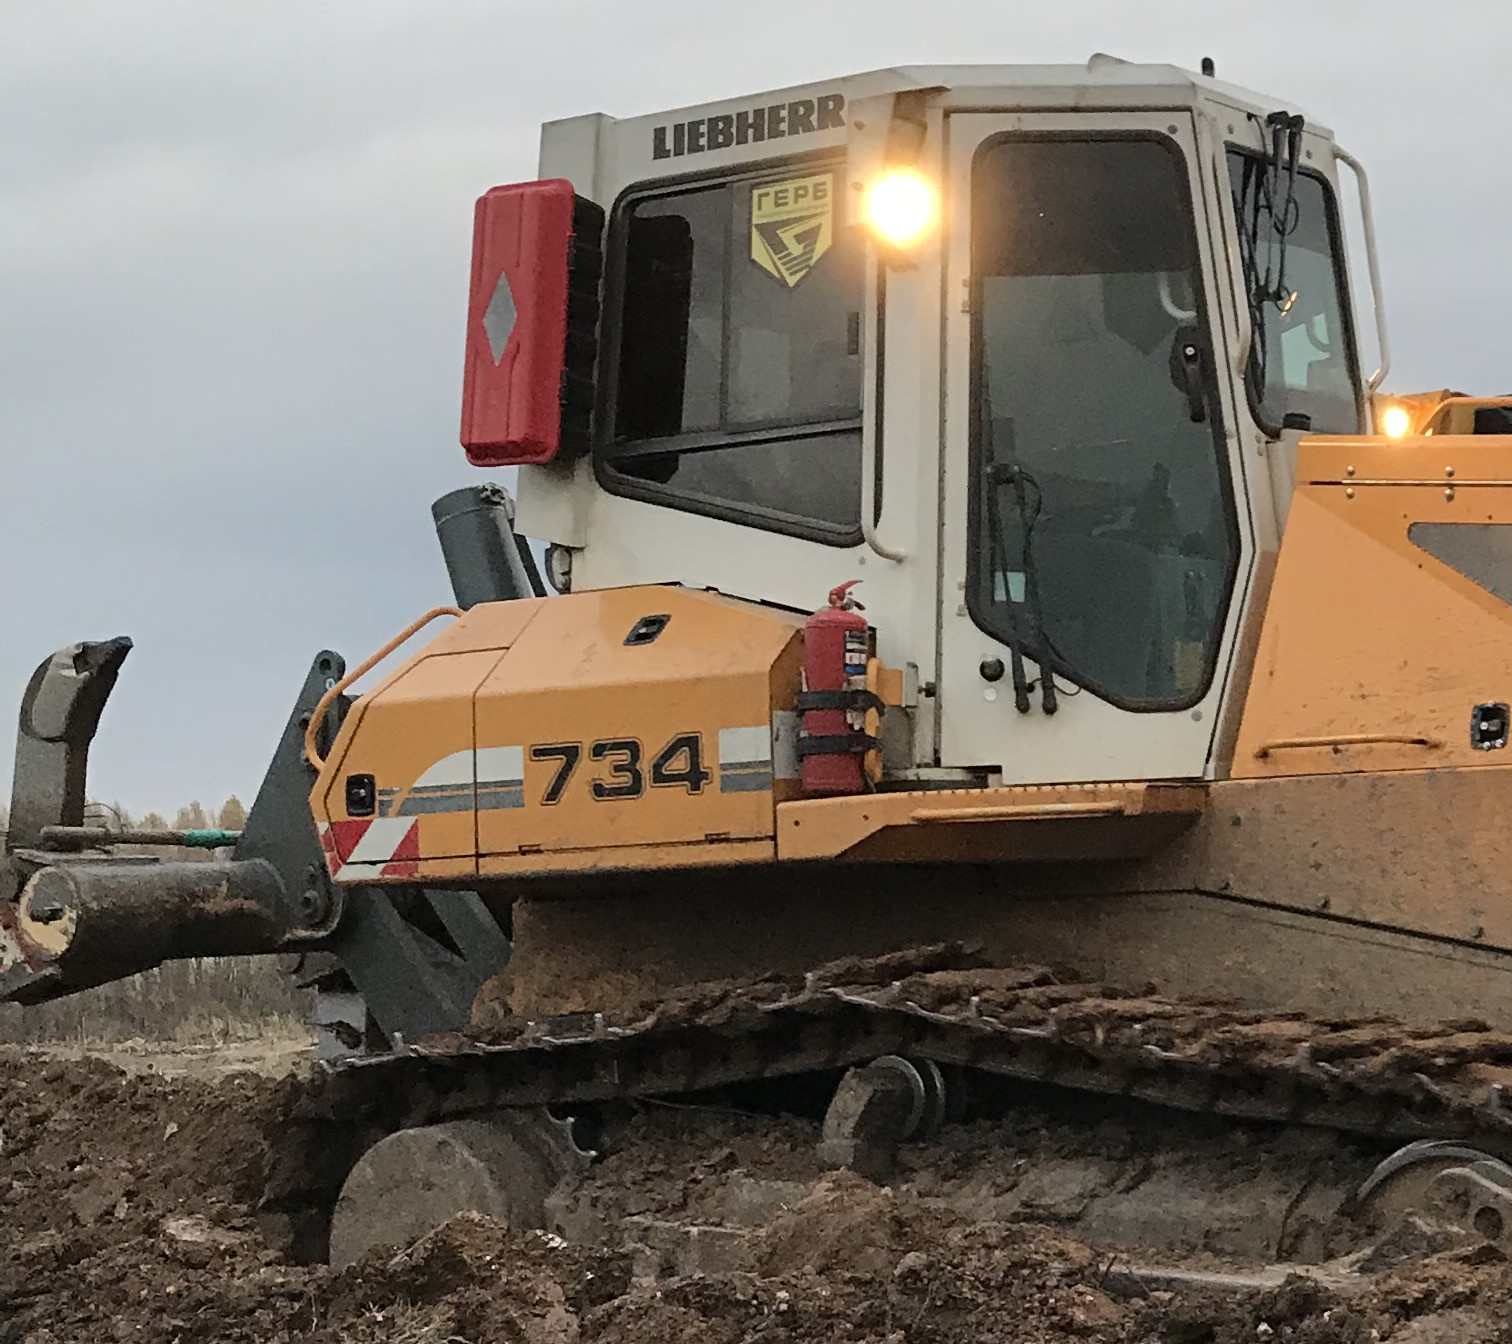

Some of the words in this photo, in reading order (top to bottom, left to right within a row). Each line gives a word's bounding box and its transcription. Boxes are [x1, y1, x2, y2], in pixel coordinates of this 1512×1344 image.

[652, 93, 846, 160] LIEBHERR
[756, 181, 828, 212] ГЕРБ
[529, 730, 714, 807] 734
